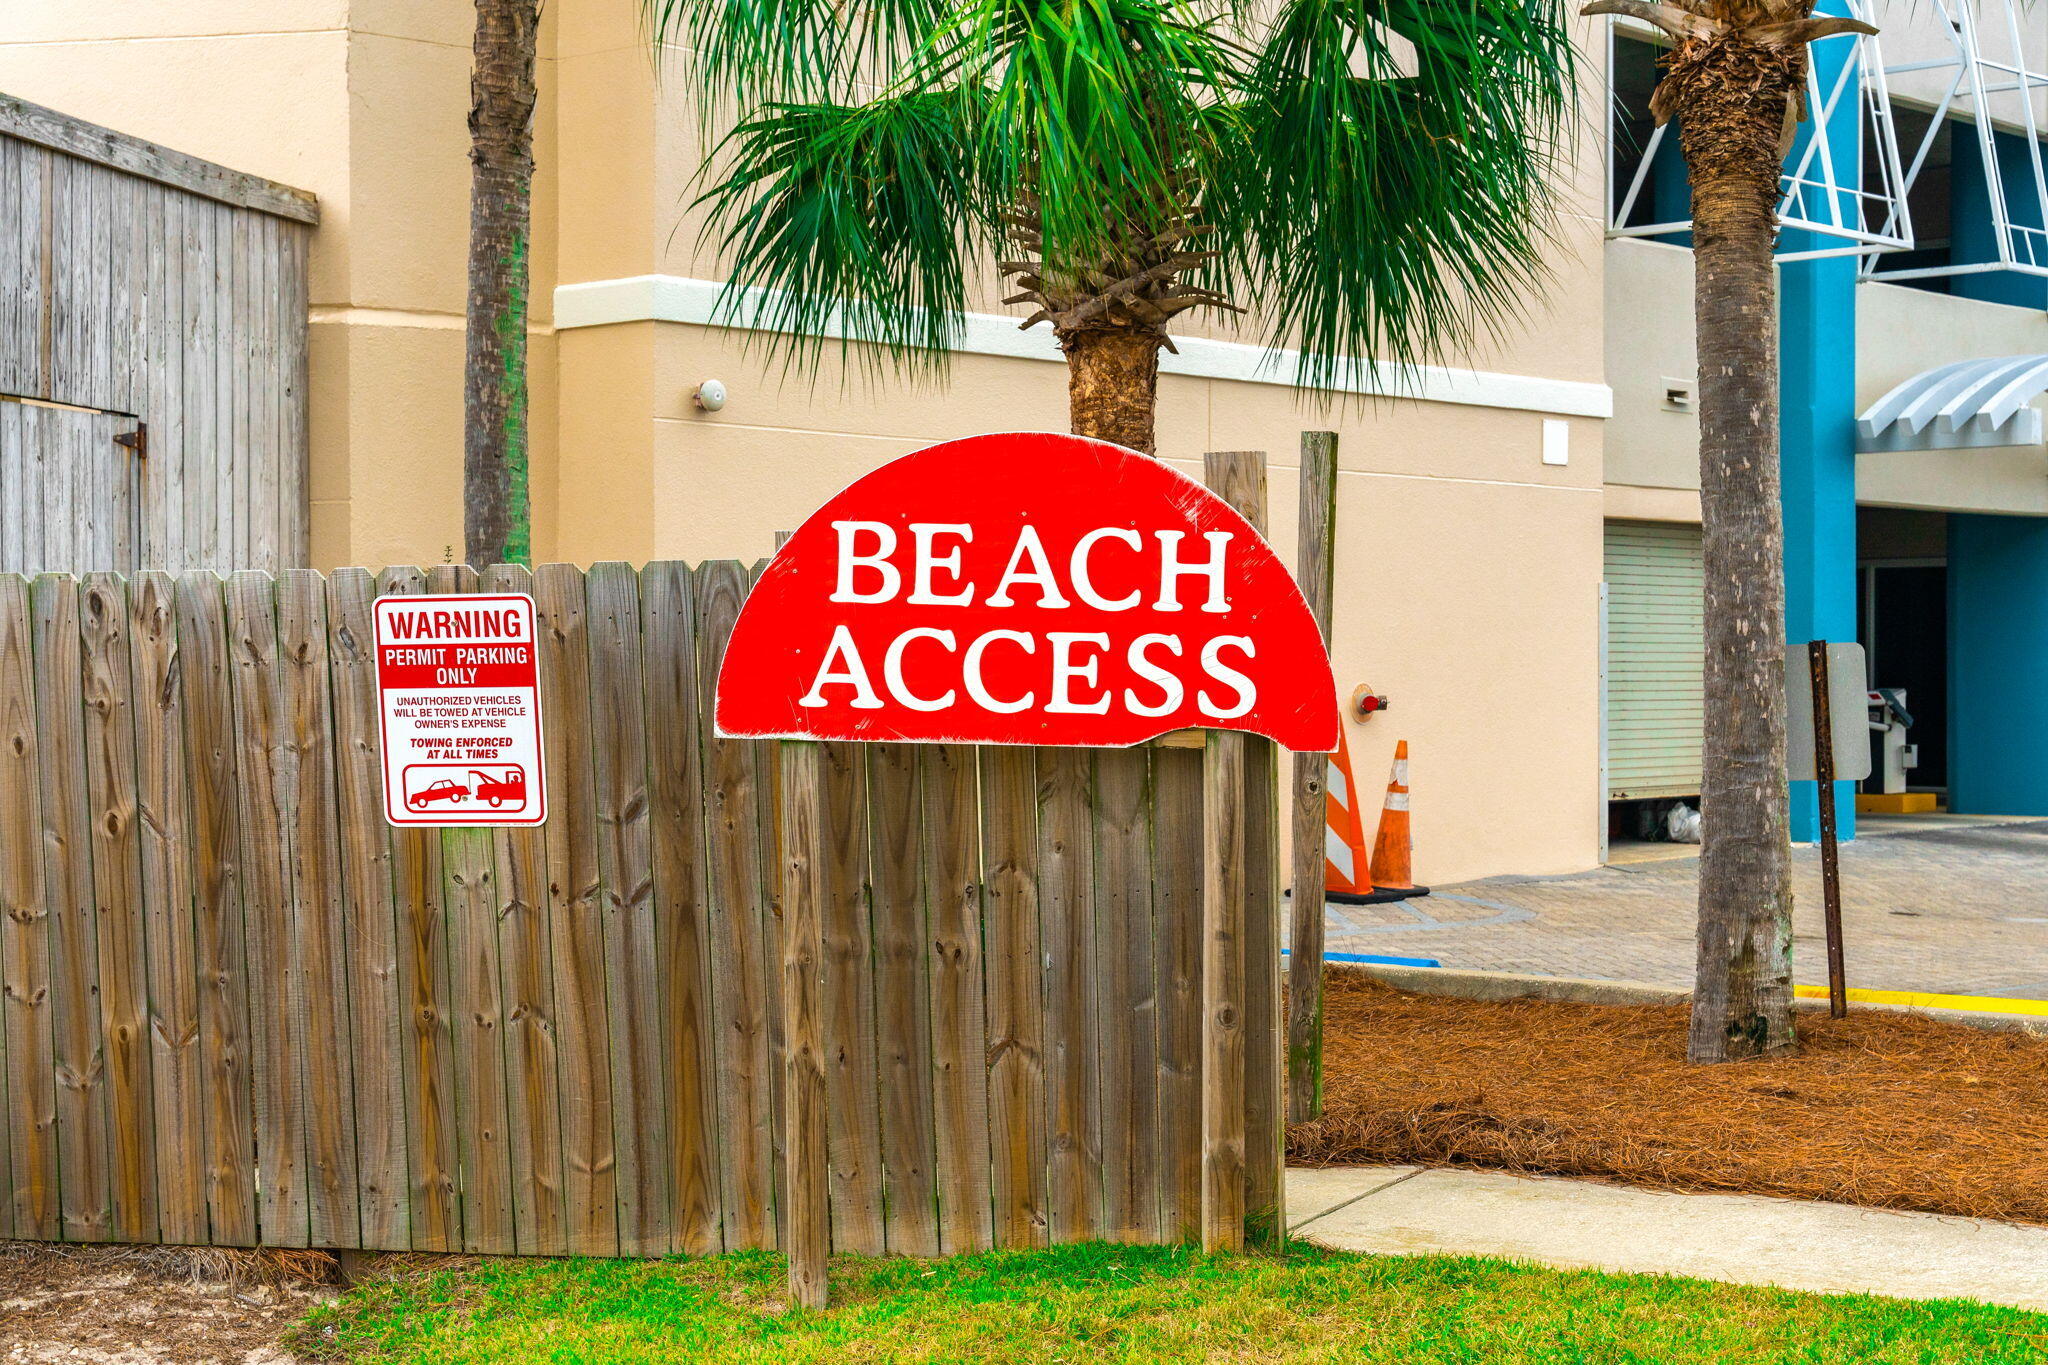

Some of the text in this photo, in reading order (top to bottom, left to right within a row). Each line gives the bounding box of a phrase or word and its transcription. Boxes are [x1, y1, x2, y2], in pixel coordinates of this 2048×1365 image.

[829, 520, 1234, 613] BEACH
[388, 609, 520, 639] WARNING
[386, 647, 527, 665] PERMIT PARKING
[437, 667, 477, 685] ONLY
[798, 624, 1258, 719] ACCESS
[397, 695, 521, 706] UNAUTHORIZED VEHICLES
[394, 707, 526, 717] WILL BE TOWED AT VEHICLE
[415, 719, 506, 728] OWNER'S EXPENSE
[411, 737, 513, 748] TOWING ENFORCED
[427, 749, 498, 759] AT ALL TIMES
